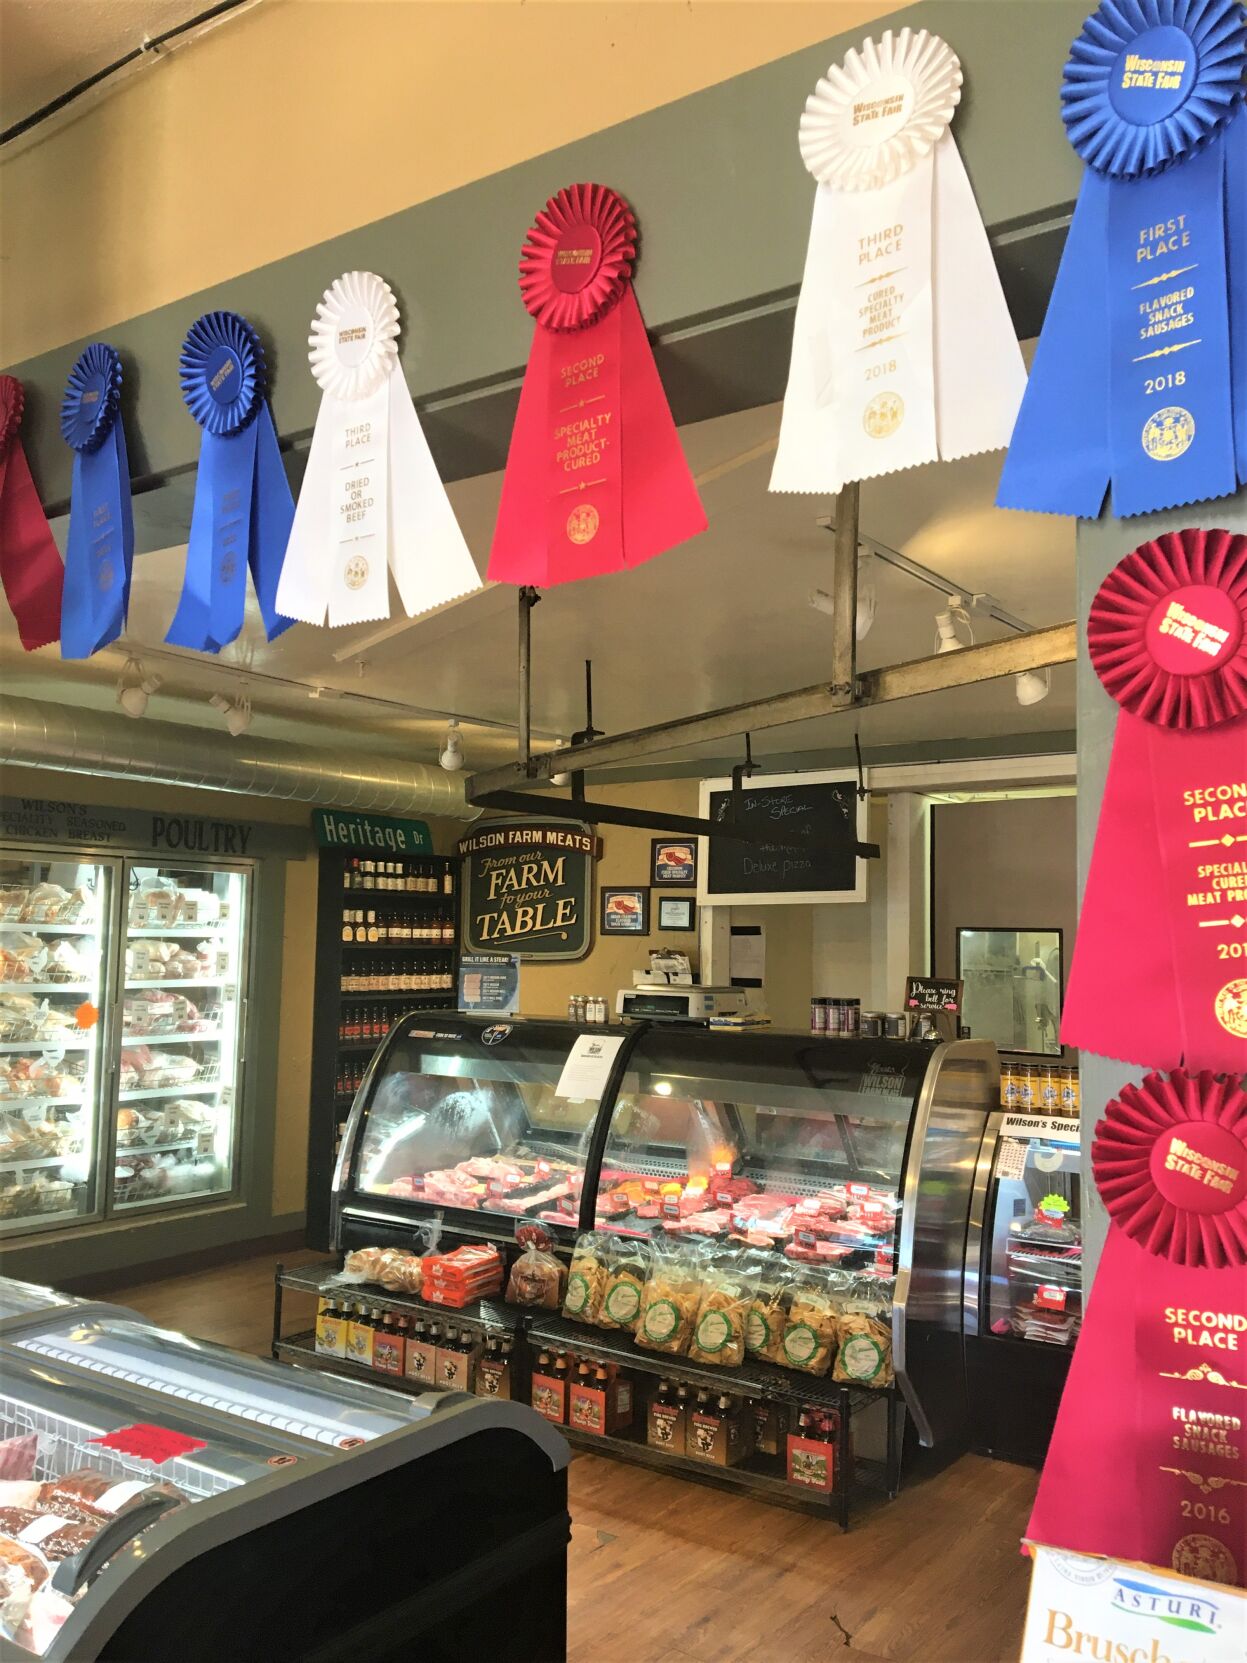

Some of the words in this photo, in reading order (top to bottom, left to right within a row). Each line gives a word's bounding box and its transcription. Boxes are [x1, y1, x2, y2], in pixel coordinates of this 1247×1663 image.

[858, 223, 904, 250] THIRD
[1139, 214, 1186, 245] FIRST
[858, 238, 902, 266] PLACE
[1136, 230, 1190, 263] PLACE
[859, 293, 904, 318] SPECIALTY
[868, 286, 896, 304] CURED
[1139, 286, 1195, 315] FLAVORED
[869, 308, 893, 324] MEAT
[1148, 302, 1184, 325] SNACK
[862, 316, 901, 338] PRODUCT
[1139, 312, 1194, 340] SAUSAGES
[560, 354, 605, 379] SECOND
[565, 368, 600, 388] PLACE
[864, 359, 897, 381] 2018
[1144, 370, 1186, 394] 2018
[345, 422, 371, 438] THIRD
[554, 412, 612, 440] SPECIALTY
[345, 434, 372, 449] PLACE
[567, 429, 598, 447] MEAT
[556, 438, 611, 463] PRODUCT-
[564, 453, 600, 472] CURED
[345, 477, 370, 492] DRIED
[350, 490, 363, 501] OR
[340, 497, 374, 515] SMOKED
[346, 510, 366, 524] BEEF
[1193, 801, 1247, 823] PLAC
[152, 816, 253, 854] POULTRY
[322, 814, 406, 852] Heritage
[413, 830, 424, 845] Dr
[459, 832, 505, 854] WILSON
[509, 830, 543, 844] FARM
[546, 831, 591, 851] MEATS
[478, 856, 516, 878] From
[519, 850, 544, 863] our
[743, 857, 778, 875] Deluxe
[487, 856, 566, 900] FARM
[500, 893, 515, 909] to
[515, 888, 553, 909] your
[1187, 891, 1222, 906] MEAT
[476, 897, 577, 940] TABLE
[910, 982, 937, 997] Please
[940, 988, 956, 997] ring
[925, 993, 939, 1003] bell
[940, 994, 955, 1006] for
[920, 1002, 944, 1010] service
[864, 1074, 903, 1090] WILSON
[1006, 1116, 1048, 1129] Wilson's
[1164, 1307, 1247, 1332] SECOND
[1173, 1326, 1239, 1351] PLACE
[1172, 1406, 1241, 1431] FLAVORED
[1184, 1423, 1228, 1443] SNACK
[1172, 1436, 1240, 1459] SAUSAGES
[1180, 1500, 1230, 1524] 2016
[1113, 1588, 1216, 1625] ASTURI
[1043, 1608, 1175, 1663] Brusch
